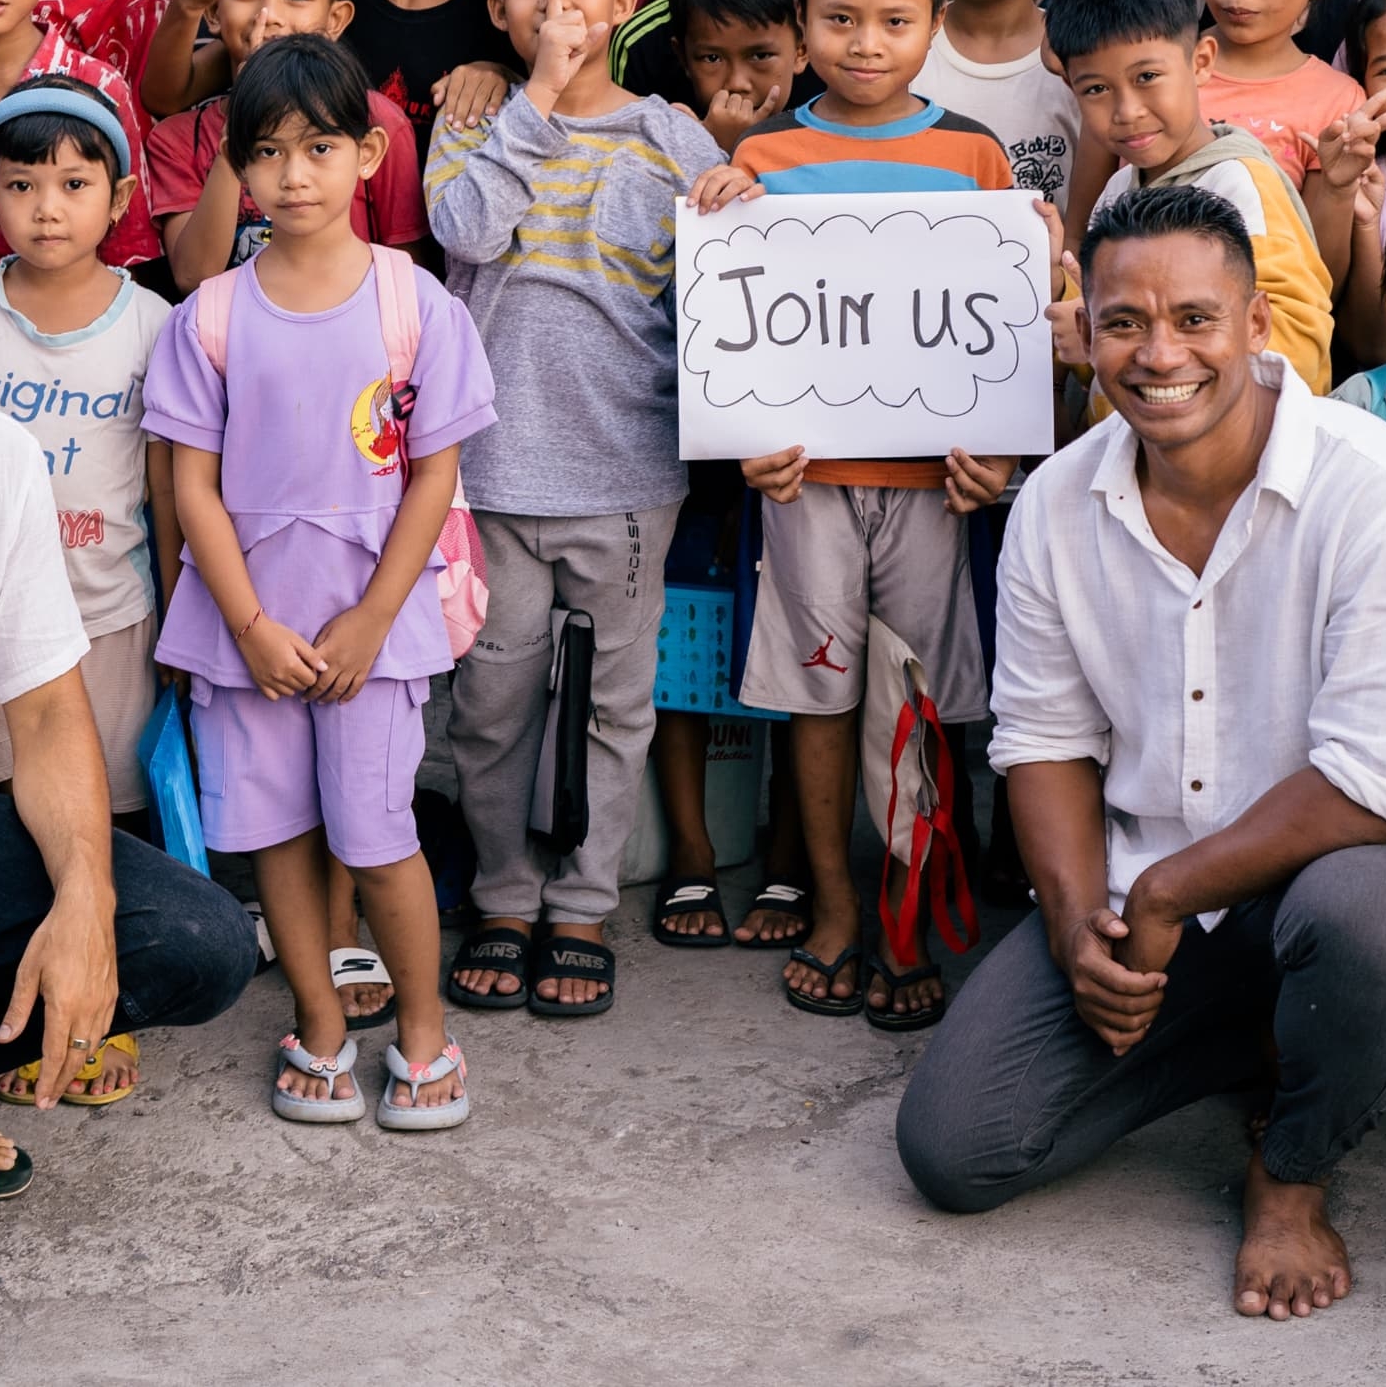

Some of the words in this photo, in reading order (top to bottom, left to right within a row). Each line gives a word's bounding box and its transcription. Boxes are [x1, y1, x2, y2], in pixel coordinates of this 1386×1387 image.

[714, 265, 875, 352] Join
[469, 942, 523, 959] VANS
[551, 950, 608, 970] VANS
